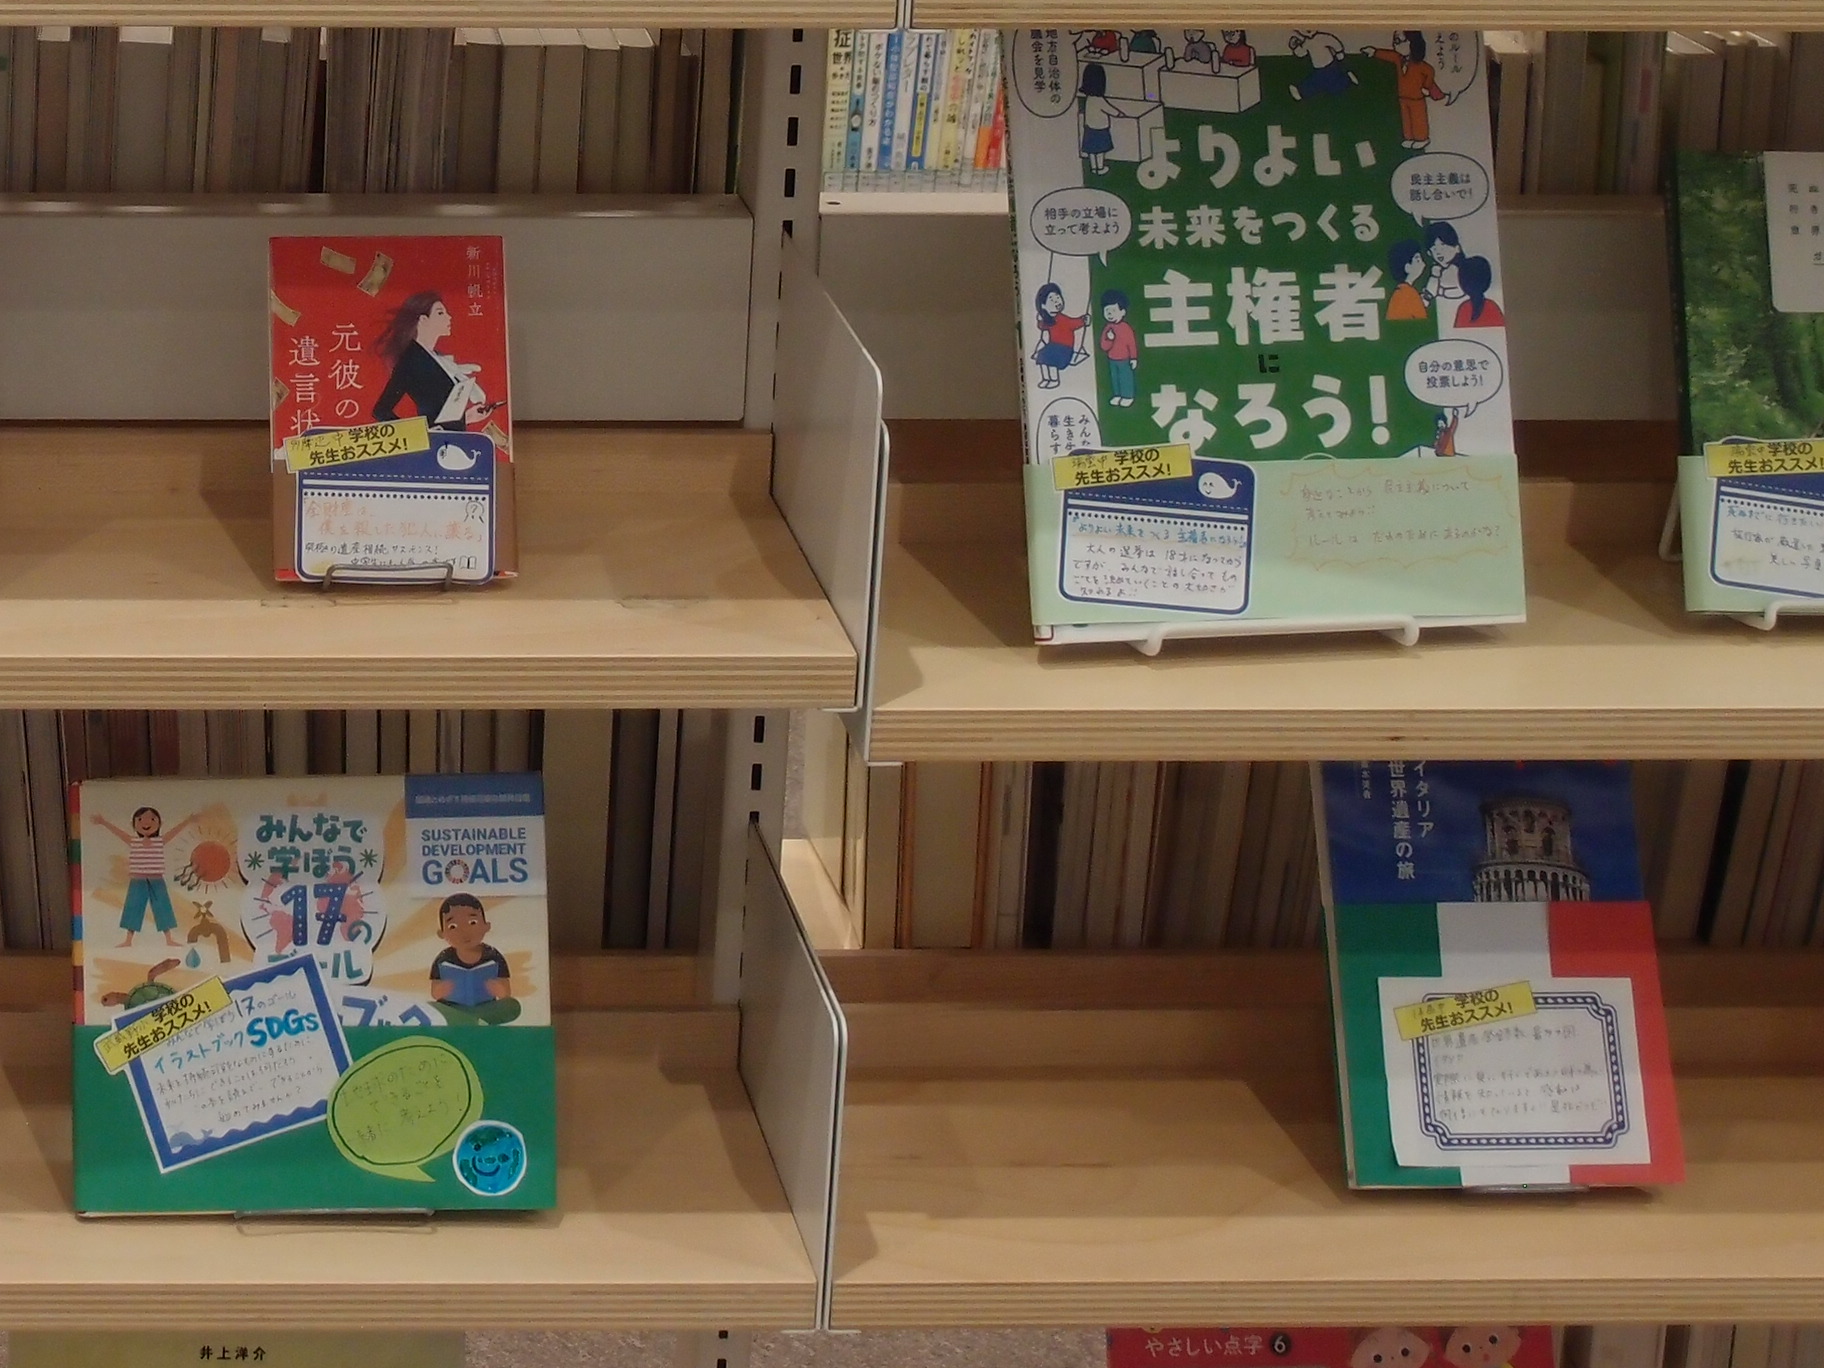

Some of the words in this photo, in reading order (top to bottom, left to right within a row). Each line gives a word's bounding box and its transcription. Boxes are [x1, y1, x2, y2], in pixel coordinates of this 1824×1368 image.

[1137, 125, 1378, 190] よりよい
[1410, 172, 1472, 186] 民主主義は
[1044, 206, 1119, 220] 相手の立場に
[1137, 204, 1380, 249] 未来をつくる
[1044, 222, 1121, 236] 立って考えよう
[466, 245, 484, 317] 新川帆立
[1143, 264, 1385, 349] 主権者
[328, 322, 364, 420] 元彼の
[1258, 354, 1280, 374] に
[1418, 360, 1489, 373] 自分の意思で
[288, 335, 321, 437] 遺言状
[1150, 375, 1391, 450] なろう!
[348, 424, 395, 444] 学校の
[309, 437, 409, 466] 先生おススメ!
[1114, 449, 1159, 465] 学校の
[1768, 442, 1813, 456] 学校の
[1076, 464, 1171, 486] 先生おススメ!
[1414, 761, 1434, 838] イタリア
[255, 813, 368, 845] みんなで
[421, 828, 526, 841] SUSTAINABLE
[1389, 761, 1416, 880] 世界遺産の旅
[268, 845, 357, 879] 学ぼう
[422, 843, 526, 856] DEVELOPMENT
[422, 857, 528, 885] GOALS
[151, 993, 194, 1023] 学校の
[1454, 990, 1499, 1008] 学校の
[124, 1001, 211, 1058] 先生おススメ!
[1421, 1002, 1514, 1032] 先生おススメ!
[154, 1032, 244, 1074] イラストブック
[247, 1009, 320, 1048] SDGs
[199, 1345, 267, 1362] 井上洋介
[1144, 1334, 1264, 1358] やさしい点字
[1274, 1336, 1287, 1354] 6
